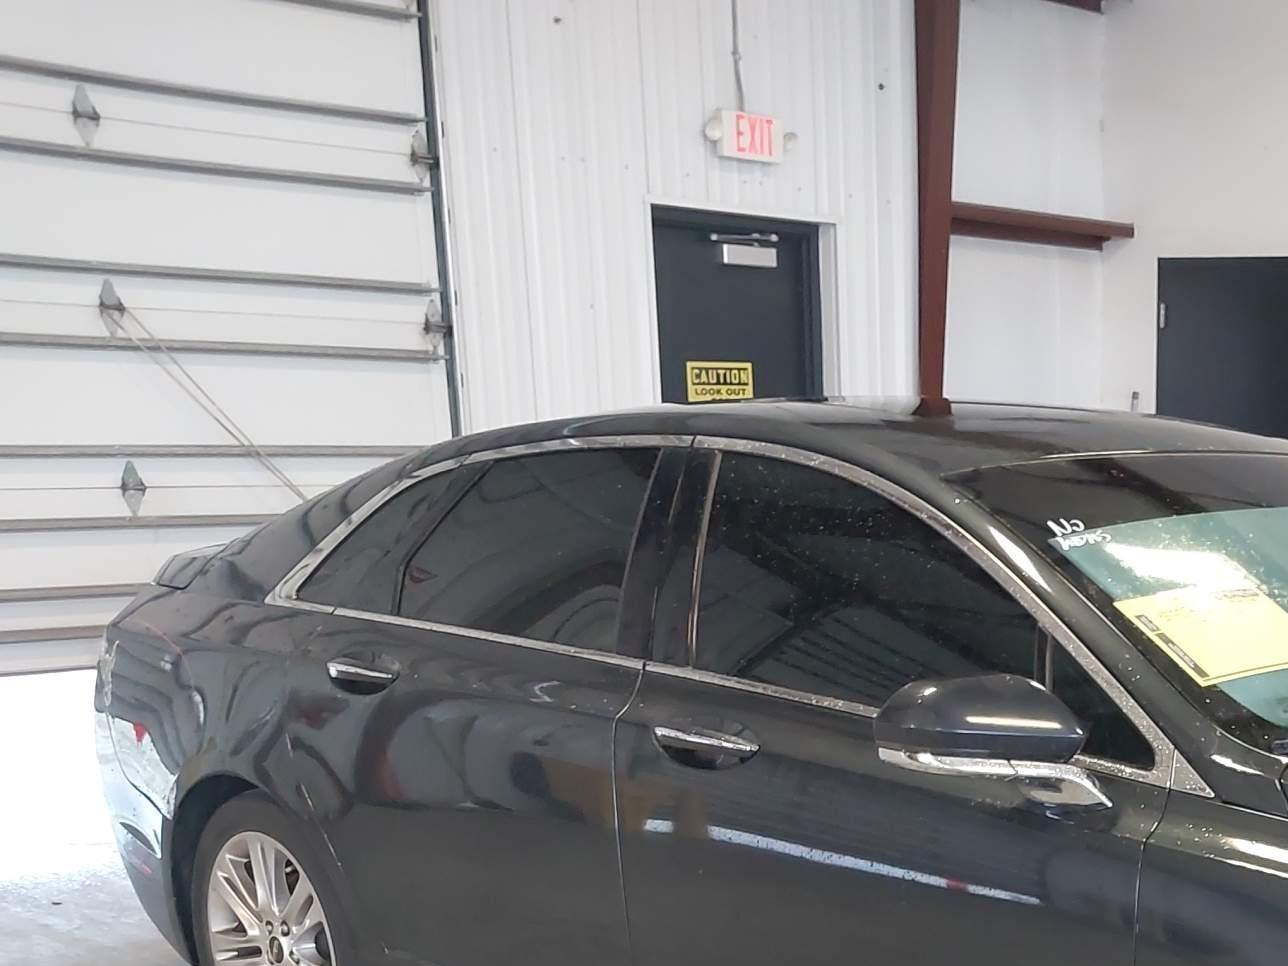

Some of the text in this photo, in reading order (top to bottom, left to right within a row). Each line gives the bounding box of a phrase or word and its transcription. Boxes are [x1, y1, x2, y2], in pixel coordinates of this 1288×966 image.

[735, 114, 774, 157] EXIT
[692, 368, 748, 384] CAUTION
[695, 387, 747, 397] LOOK OUT
